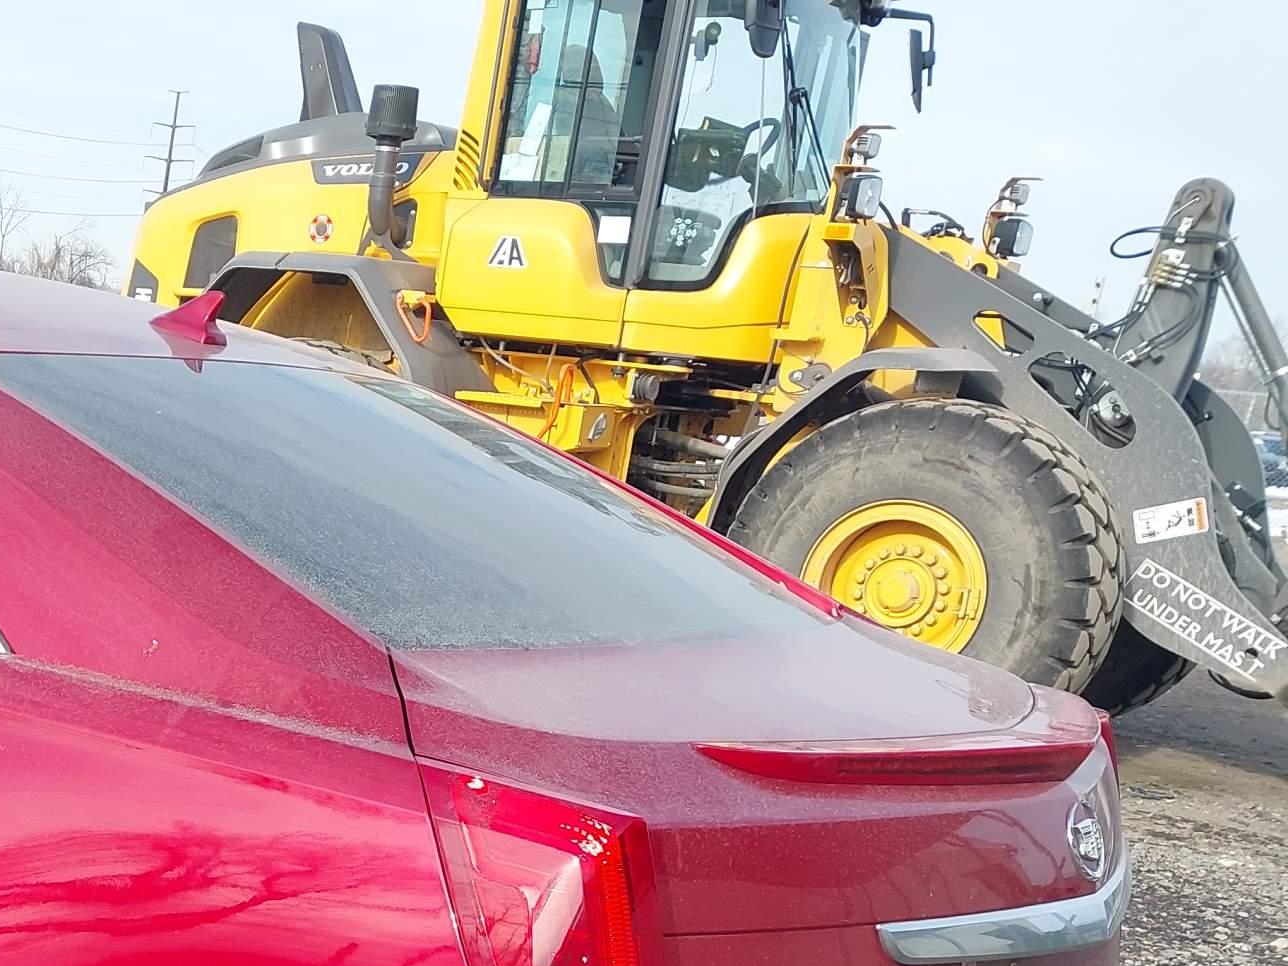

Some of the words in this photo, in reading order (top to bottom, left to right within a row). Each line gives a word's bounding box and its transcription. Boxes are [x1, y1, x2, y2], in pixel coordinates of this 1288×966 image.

[323, 162, 410, 177] VOLO
[1132, 588, 1202, 641] UNDER
[1200, 631, 1265, 675] MAST
[1136, 562, 1172, 589] DO
[1170, 582, 1222, 618] NOT
[1221, 611, 1285, 660] WALK
